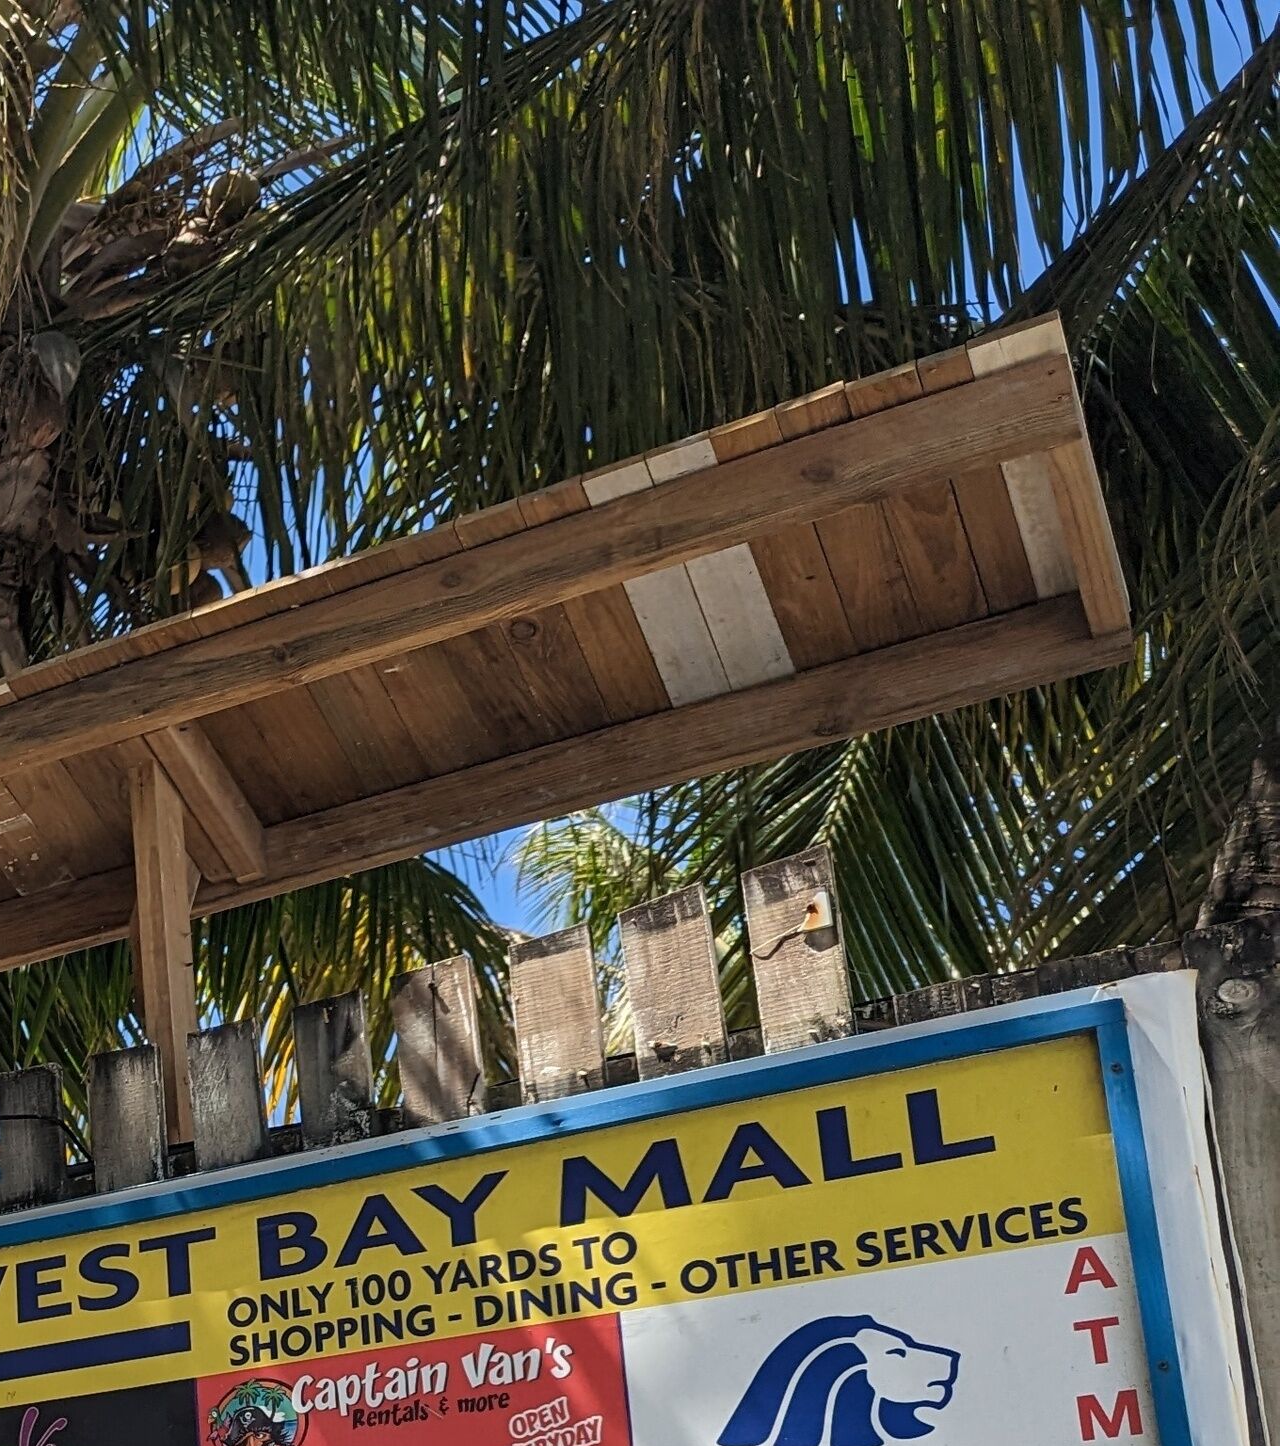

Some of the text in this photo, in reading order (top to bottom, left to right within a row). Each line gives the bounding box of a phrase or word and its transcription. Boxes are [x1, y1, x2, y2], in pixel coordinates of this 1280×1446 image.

[257, 1170, 509, 1281] BAY
[560, 1089, 996, 1226] MALL
[227, 1231, 638, 1327] ONLY 100 YARDS TO
[229, 1198, 1089, 1366] SHOPPING DINING OTHER SERVICES
[291, 1336, 574, 1419] Captain Van's
[352, 1392, 510, 1430] Rentals more
[508, 1396, 569, 1439] OPEN
